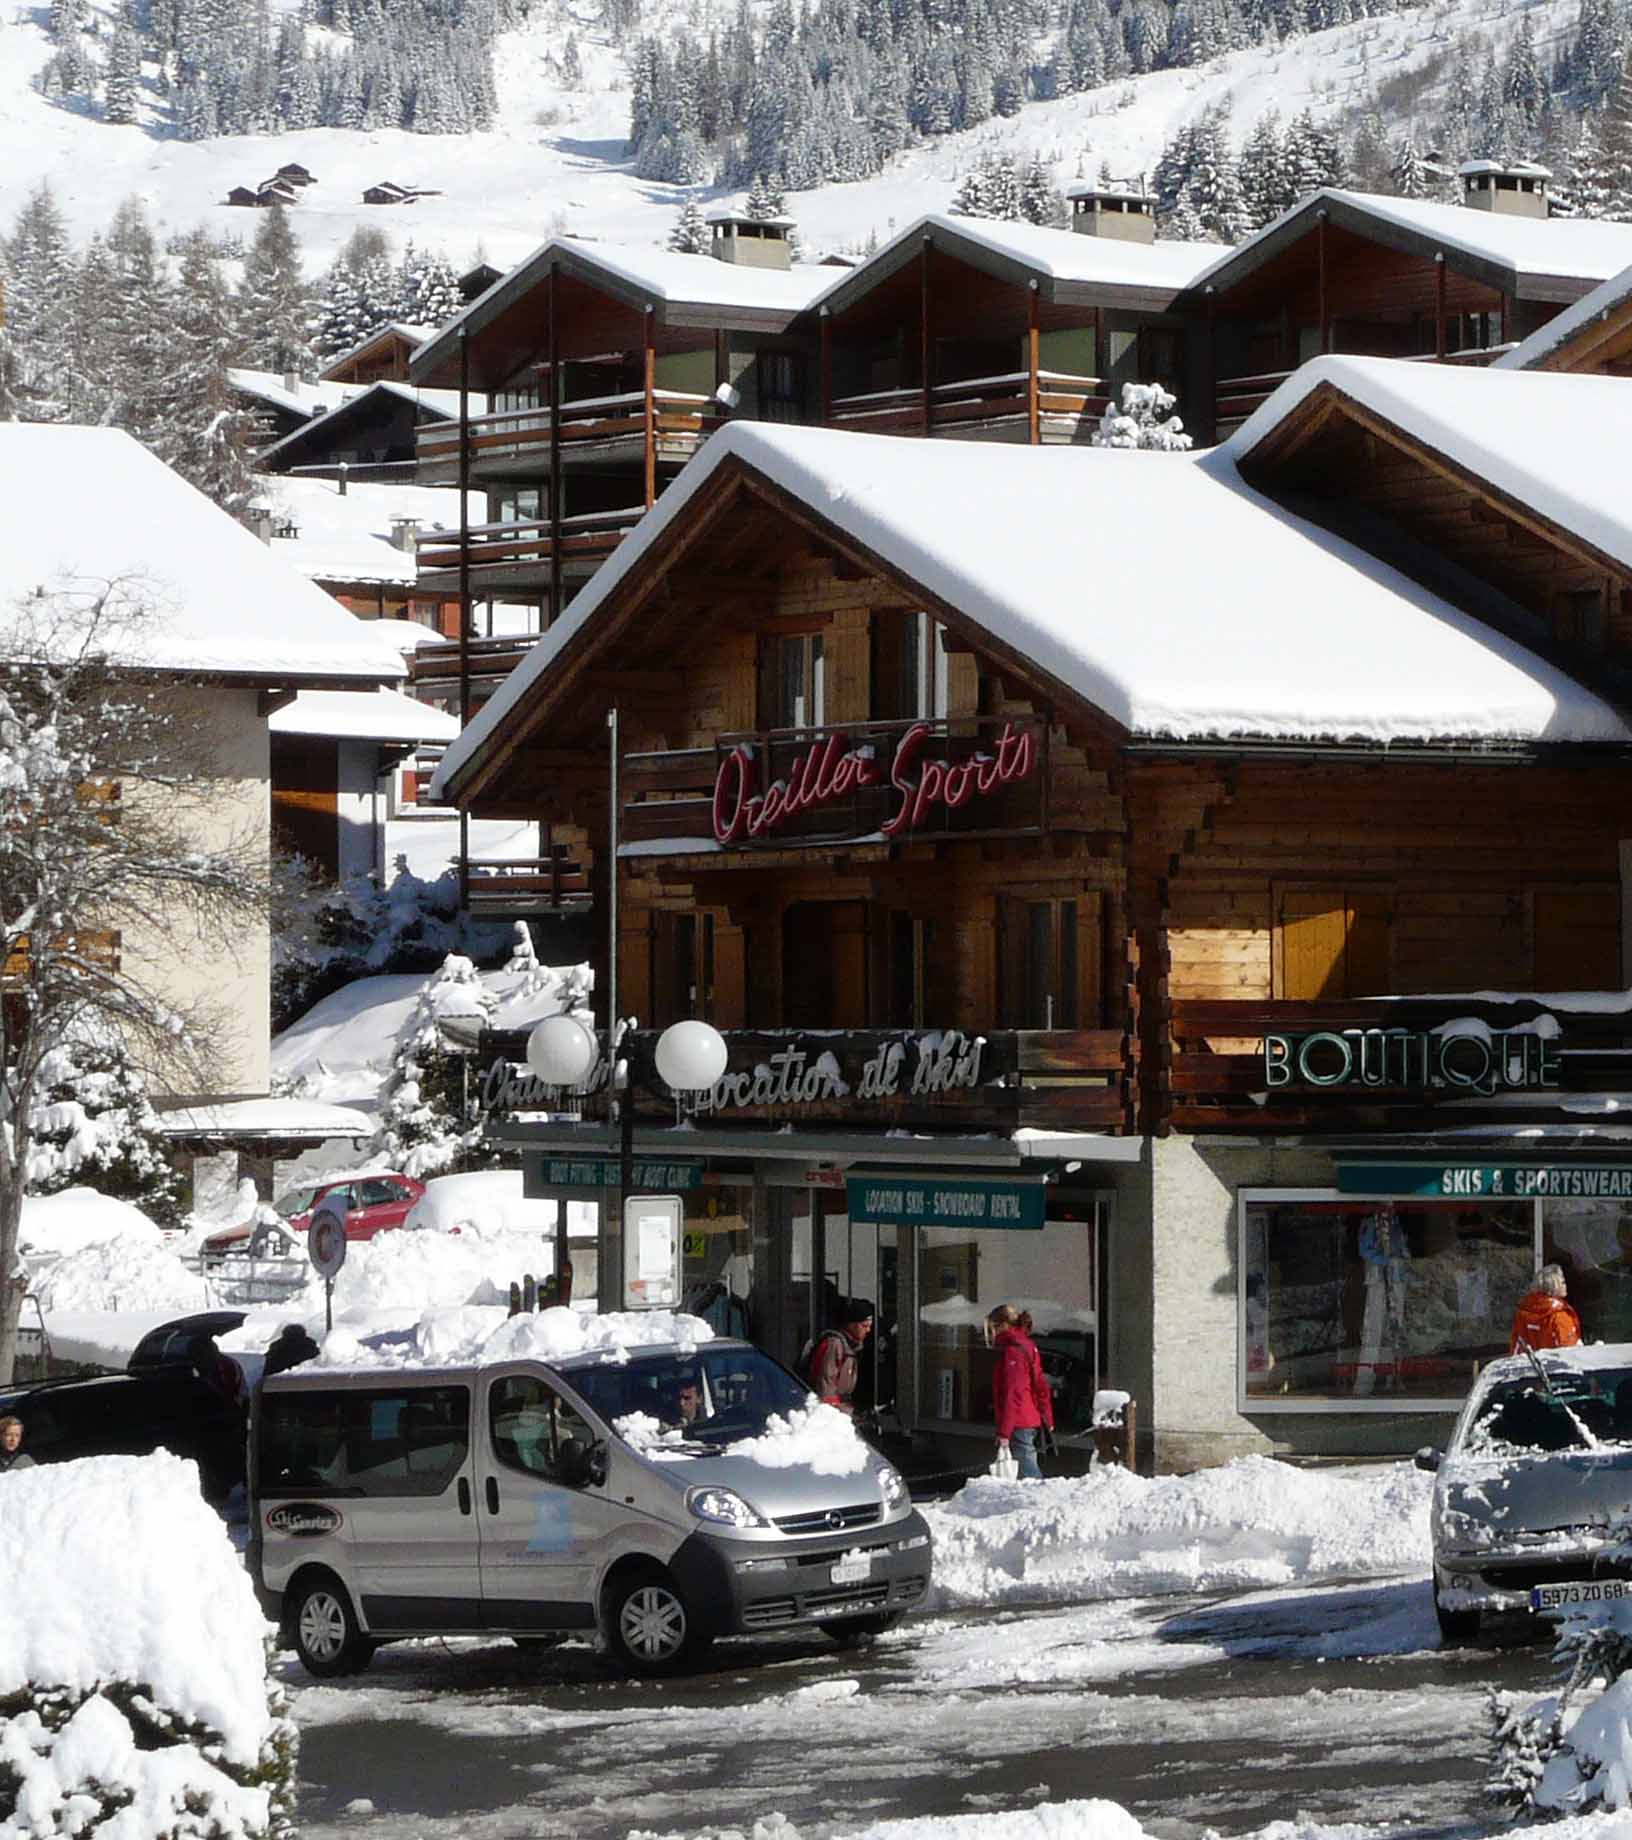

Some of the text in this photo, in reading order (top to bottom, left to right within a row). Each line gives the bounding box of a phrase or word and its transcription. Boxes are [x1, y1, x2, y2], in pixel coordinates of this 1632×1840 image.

[712, 721, 1034, 842] Oreiller Sports
[857, 1042, 904, 1099] de
[1264, 1030, 1560, 1096] BOUTIQUE
[1442, 1168, 1632, 1195] SKIS & SPORTSWEAR
[865, 1189, 903, 1214] LOCATION
[906, 1190, 924, 1215] SKIS
[933, 1191, 986, 1217] SNOWBOARD
[991, 1194, 1021, 1219] RENTAL
[1542, 1588, 1580, 1605] 5973
